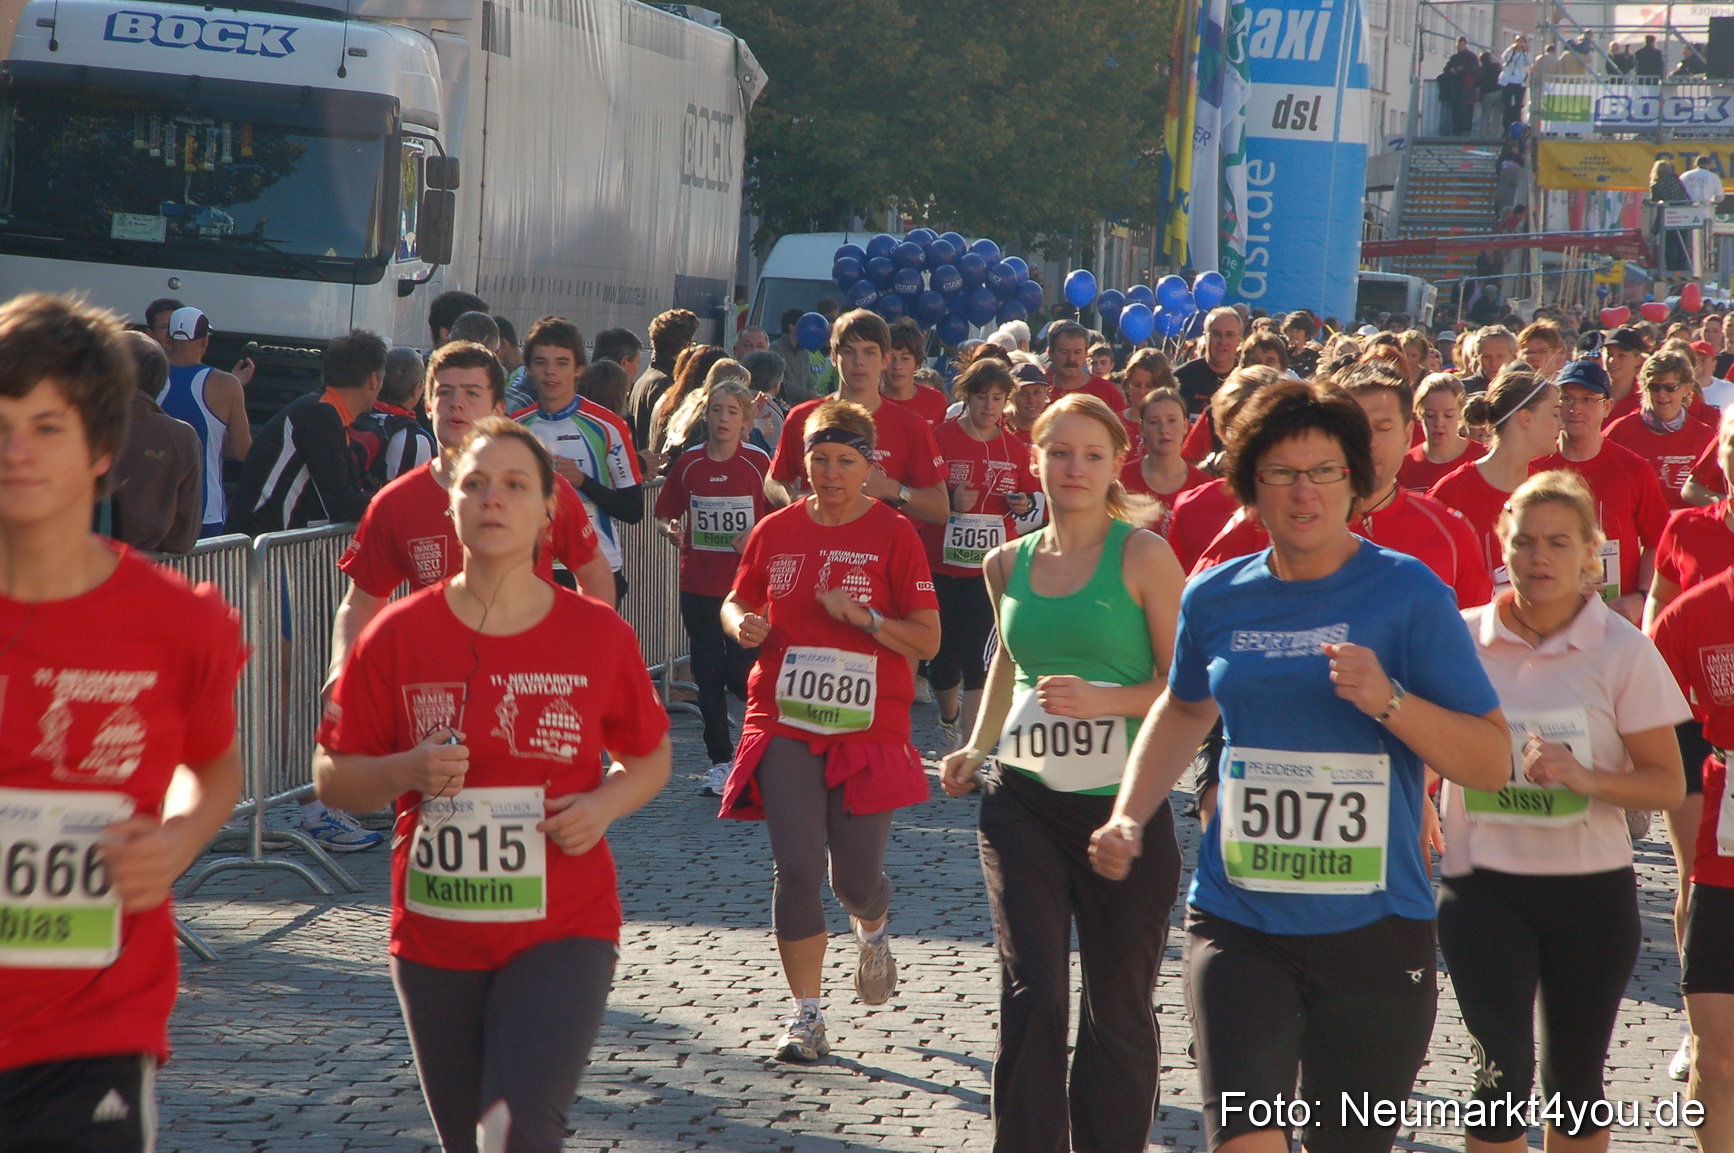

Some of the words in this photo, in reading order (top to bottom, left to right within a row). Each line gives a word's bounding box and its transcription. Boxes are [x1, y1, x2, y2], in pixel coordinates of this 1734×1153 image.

[103, 10, 299, 58] BOCK
[1272, 93, 1321, 131] dsl
[1595, 95, 1732, 123] BOCK
[698, 511, 747, 532] 5189
[952, 527, 999, 549] 5050
[508, 673, 588, 688] NEUMARKTER
[784, 669, 871, 706] 10680
[1010, 720, 1114, 758] 10097
[1242, 787, 1366, 842] 5073
[1498, 787, 1554, 816] Sissy
[1253, 844, 1353, 879] Birgitta
[426, 875, 513, 903] Kathrin
